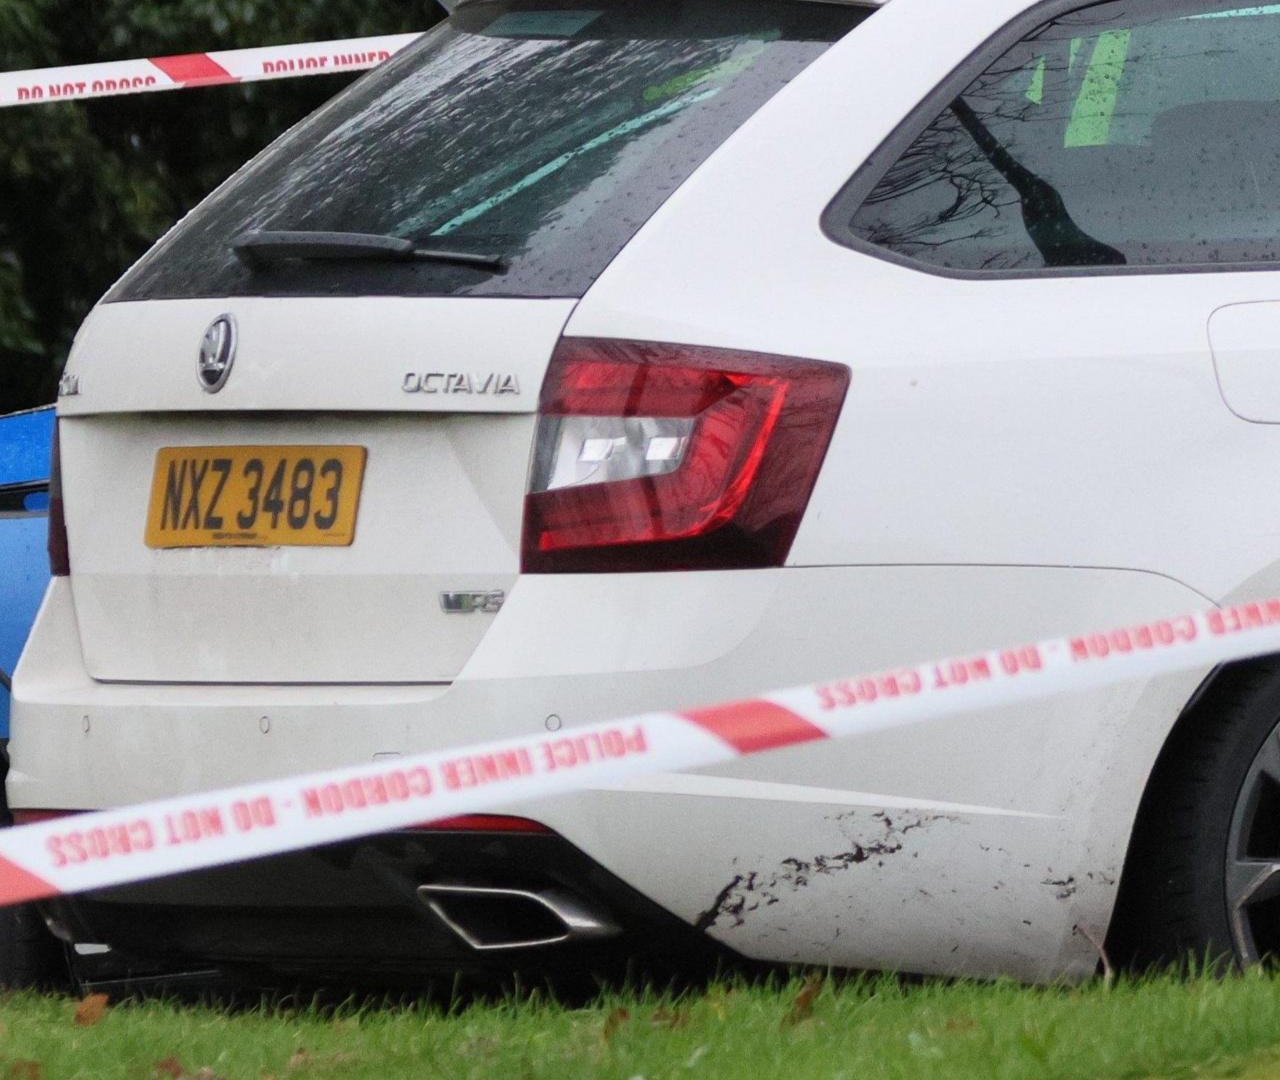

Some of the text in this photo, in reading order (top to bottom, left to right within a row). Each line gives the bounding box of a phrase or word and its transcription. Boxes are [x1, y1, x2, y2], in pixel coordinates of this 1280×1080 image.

[401, 372, 520, 395] OCTAVIA
[159, 457, 343, 531] NXZ 3483
[1071, 619, 1199, 660] CORDON
[937, 658, 993, 690] NOT
[999, 645, 1046, 677] DO
[816, 669, 924, 710] CROSS
[543, 724, 649, 772] POLICE
[442, 750, 535, 791] INNER
[303, 767, 435, 818] CORDON
[163, 806, 225, 846] NOT
[232, 796, 279, 834] DO
[46, 818, 156, 868] CROSS
